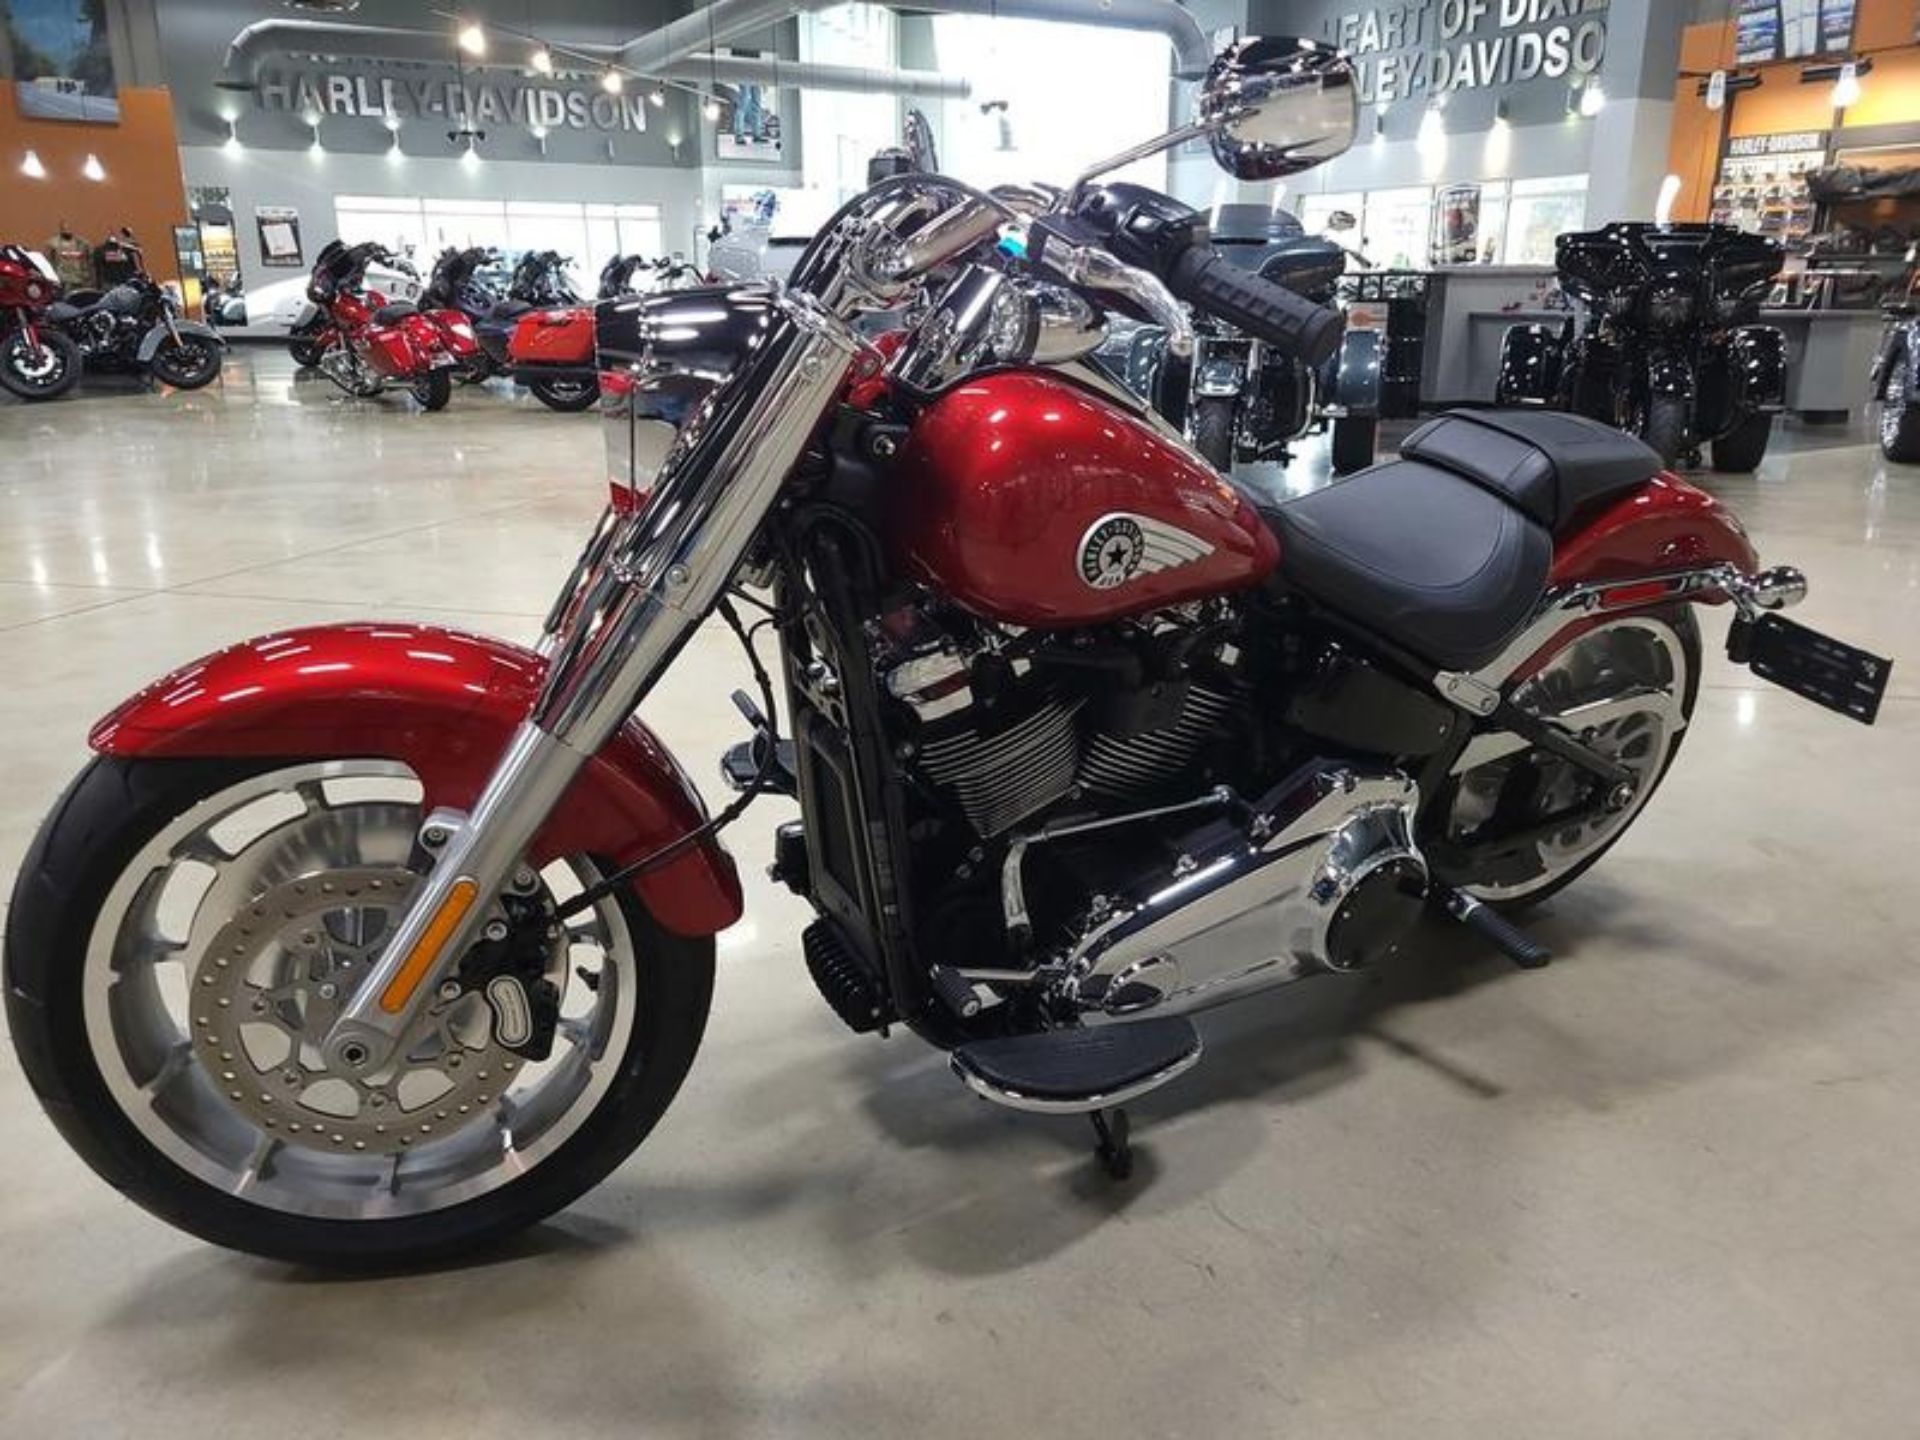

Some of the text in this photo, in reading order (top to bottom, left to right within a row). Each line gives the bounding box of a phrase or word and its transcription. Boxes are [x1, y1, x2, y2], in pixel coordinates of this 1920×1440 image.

[1323, 6, 1427, 53] HEART
[1439, 0, 1487, 39] OF
[1355, 20, 1604, 101] LEY-DAVIDSO
